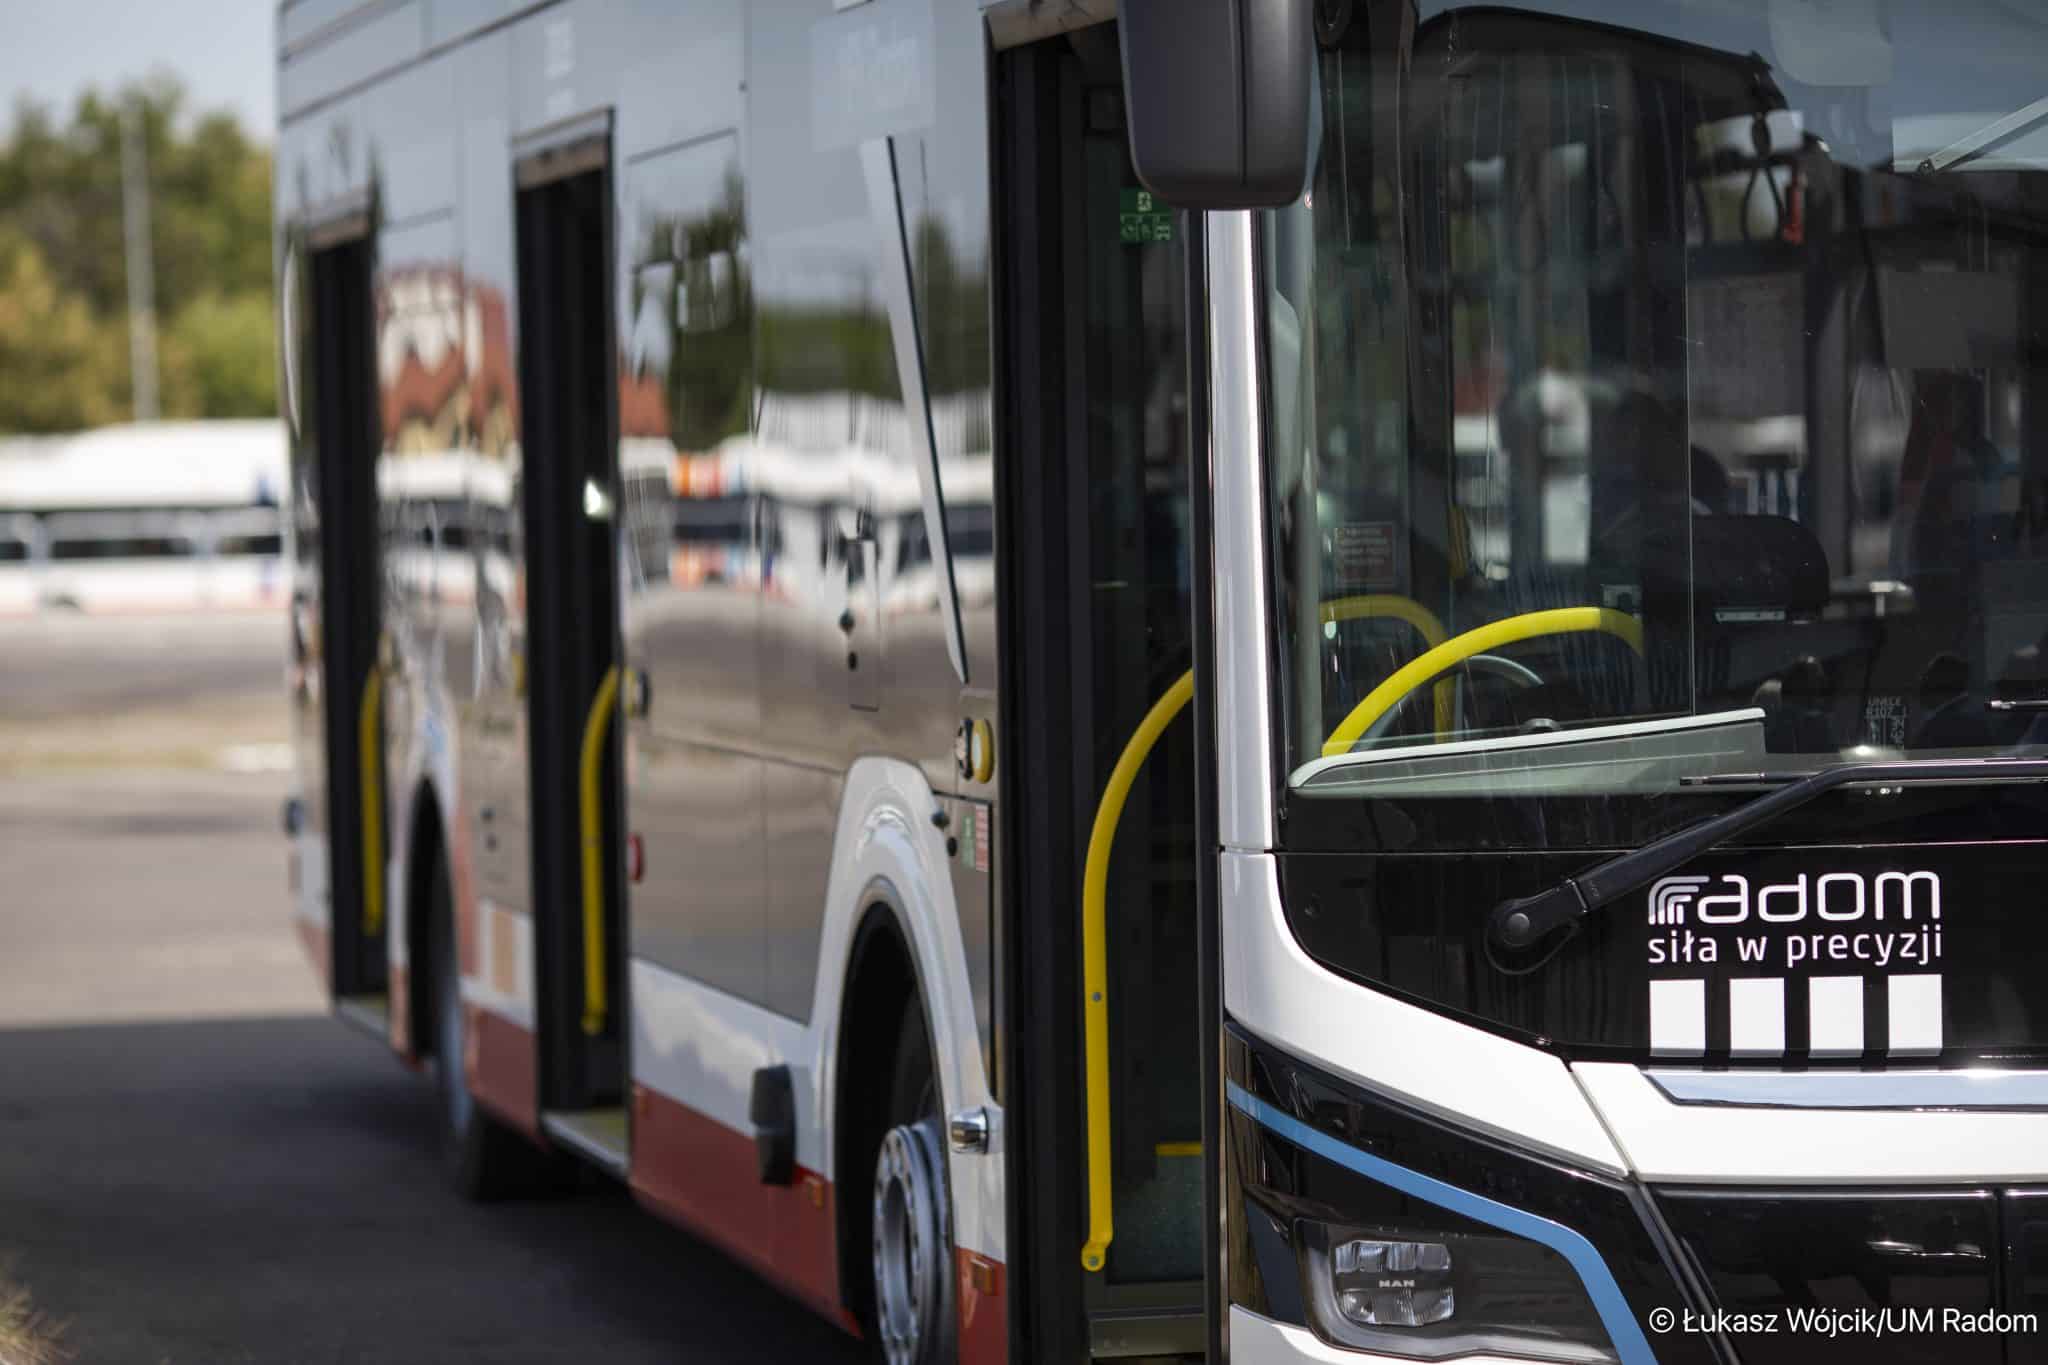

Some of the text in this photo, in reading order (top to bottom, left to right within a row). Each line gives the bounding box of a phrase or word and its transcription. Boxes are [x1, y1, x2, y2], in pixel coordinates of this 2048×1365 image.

[1647, 924, 1942, 969] siła w precyzji
[1378, 1279, 1416, 1288] MAN
